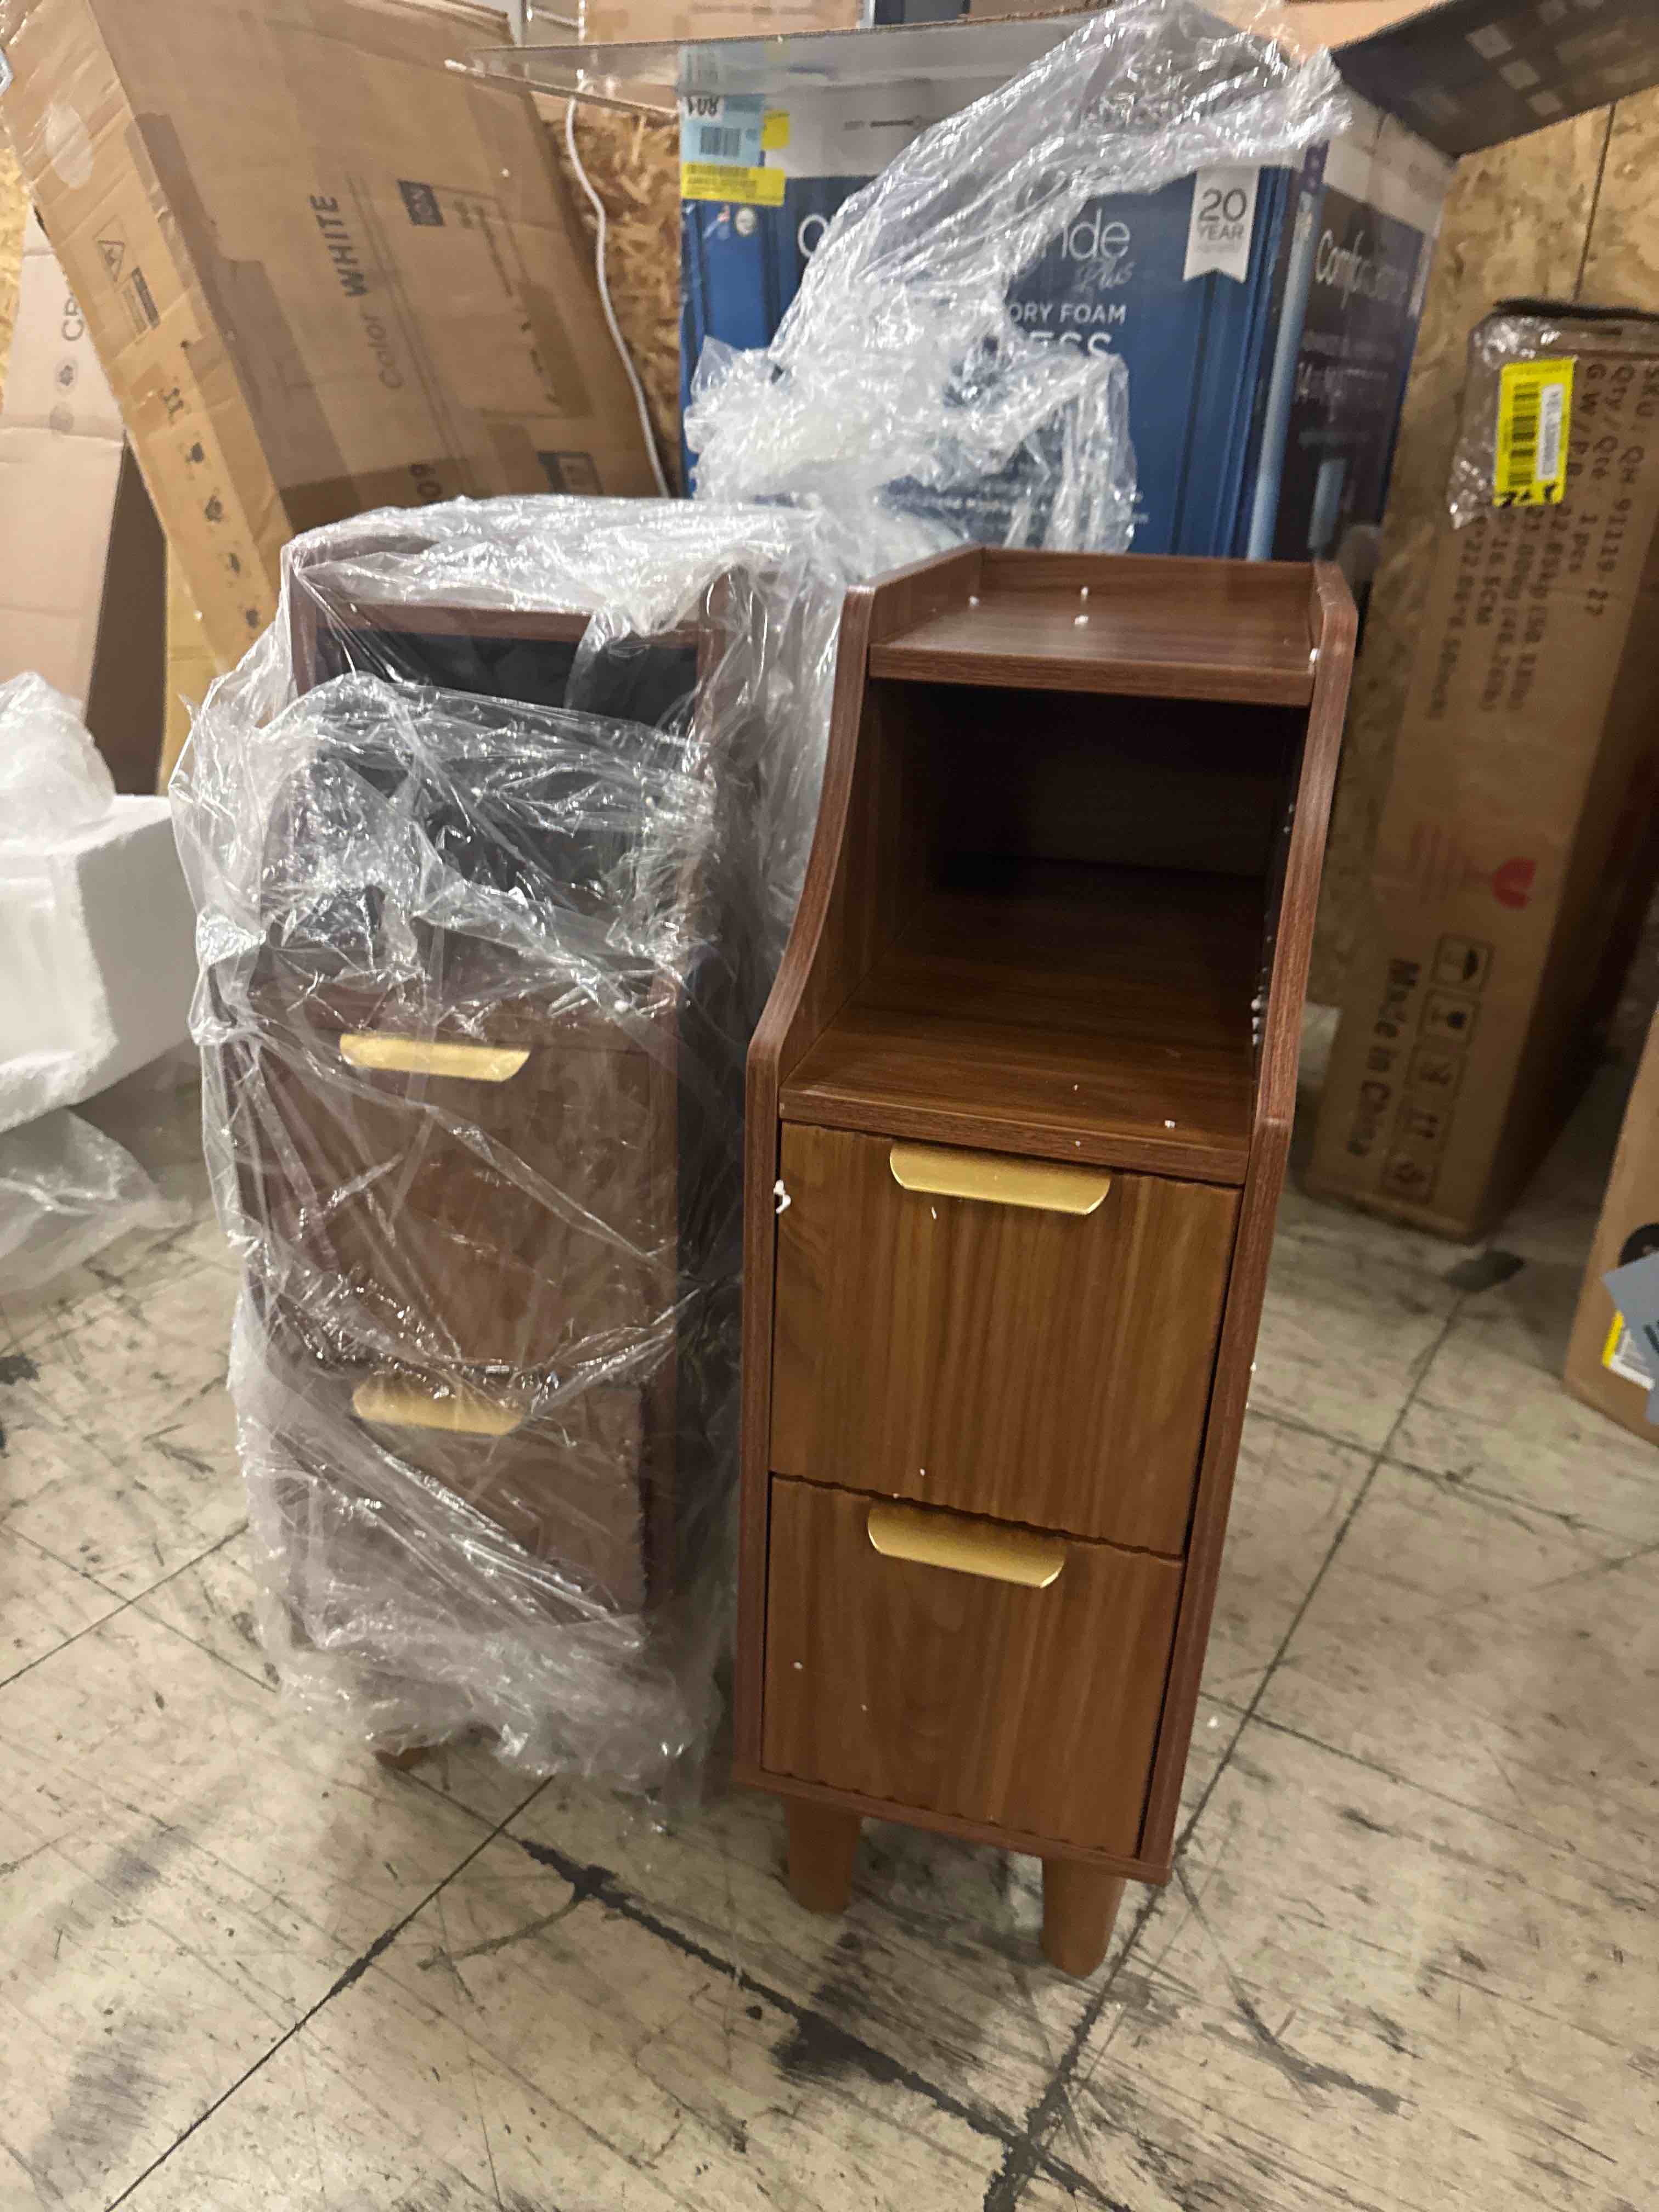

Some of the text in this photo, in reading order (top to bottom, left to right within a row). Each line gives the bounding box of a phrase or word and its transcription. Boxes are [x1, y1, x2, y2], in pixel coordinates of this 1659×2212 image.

[1198, 187, 1247, 222] 20
[308, 194, 371, 298] WHITE
[1196, 222, 1245, 240] YEAR
[1008, 300, 1127, 326] ORY FOAM
